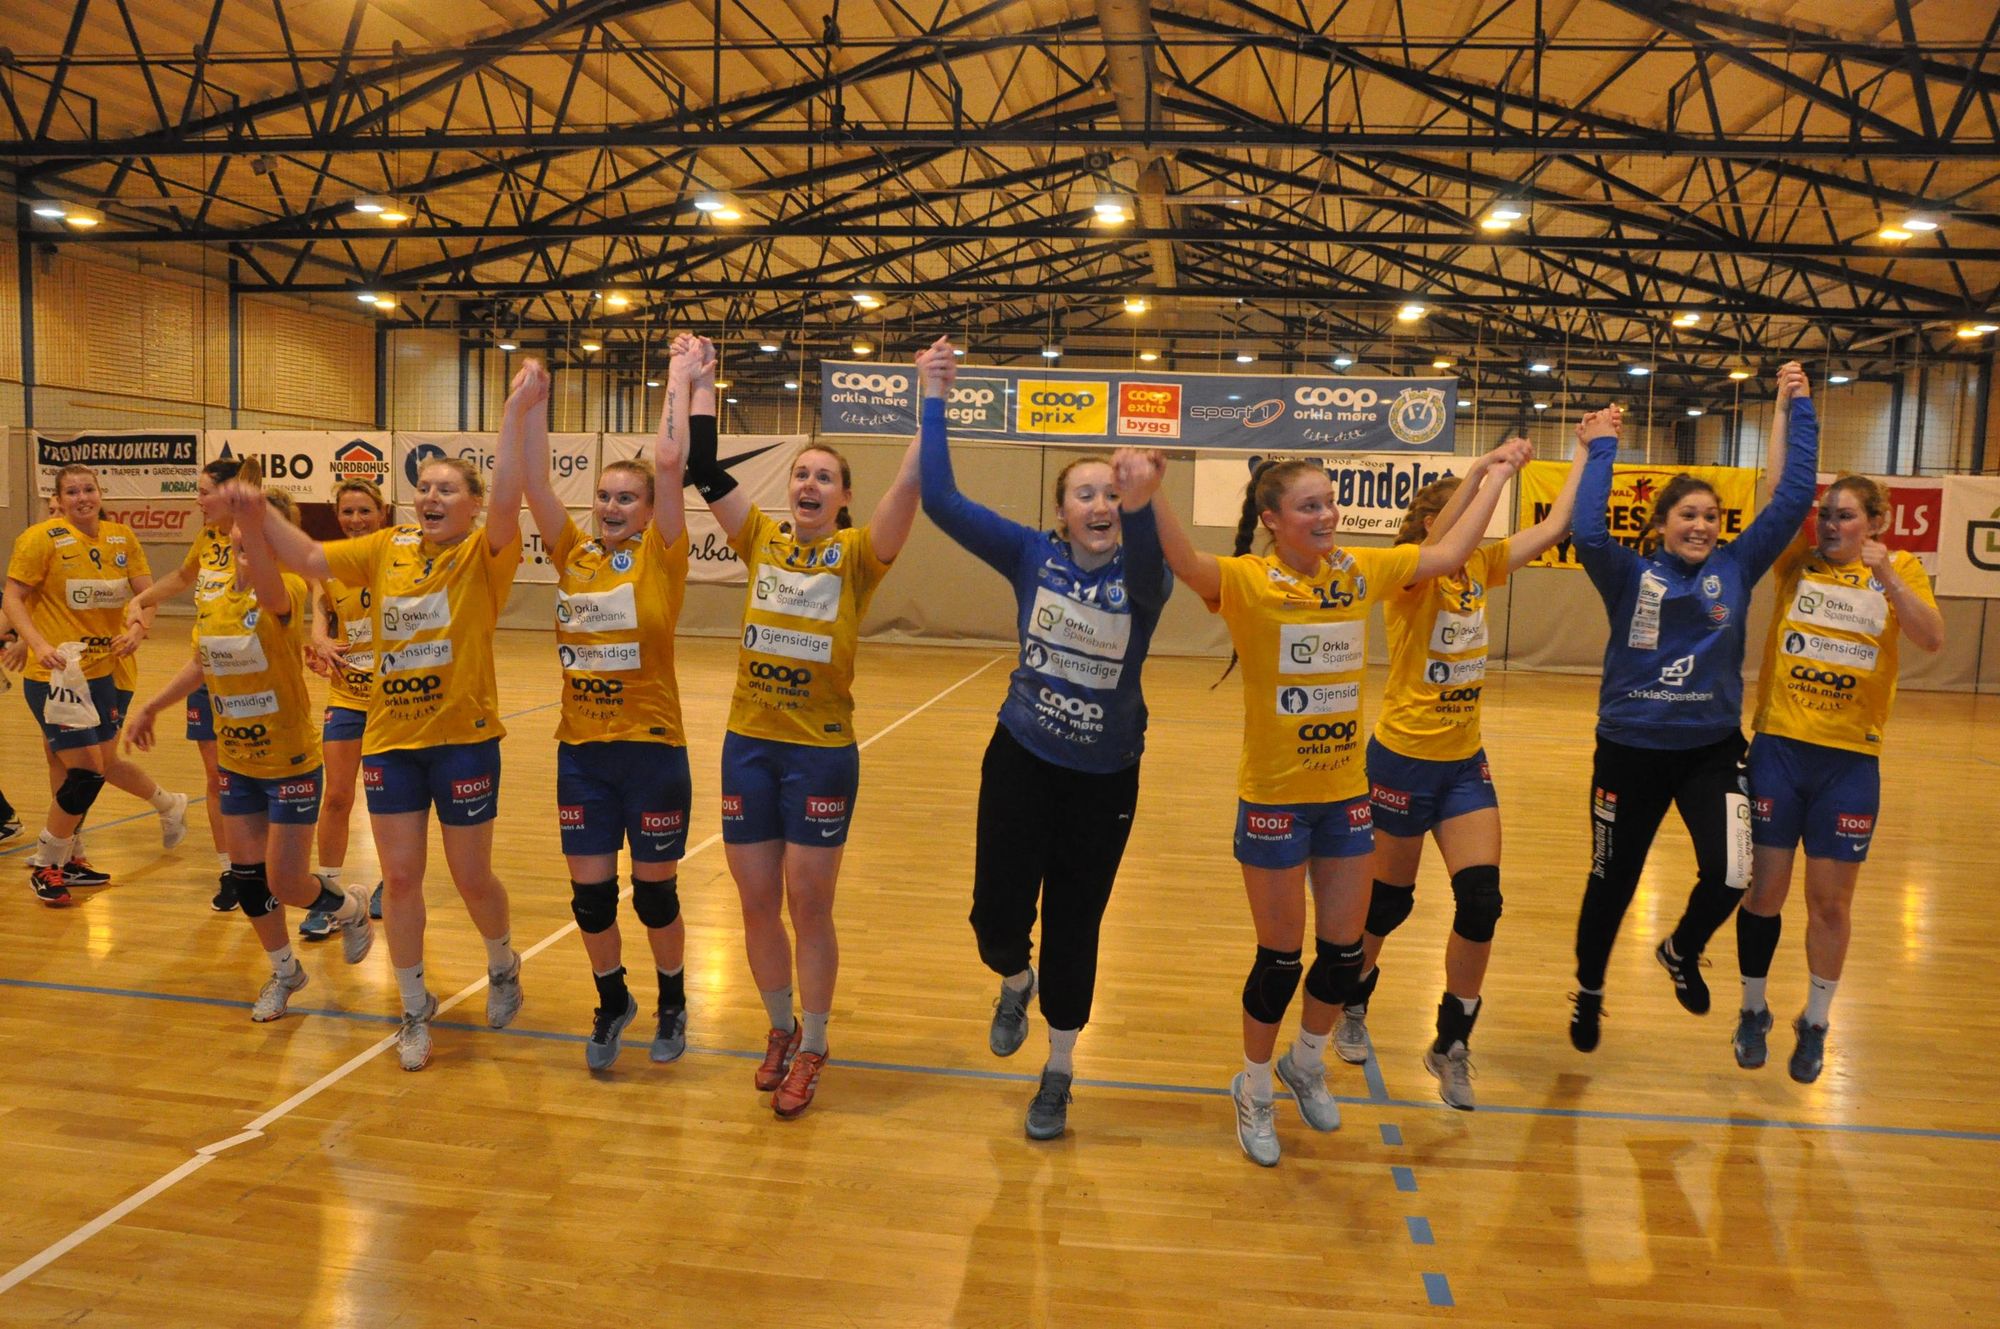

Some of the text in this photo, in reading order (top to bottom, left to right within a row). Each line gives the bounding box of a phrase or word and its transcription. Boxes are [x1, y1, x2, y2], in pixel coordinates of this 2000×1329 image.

[831, 370, 909, 397] coop
[831, 391, 908, 407] orkla møre
[947, 388, 994, 407] oop
[1031, 390, 1095, 410] coop
[1128, 390, 1172, 404] coop
[1294, 386, 1378, 411] coop
[944, 408, 986, 424] ega
[1127, 403, 1166, 414] extra
[1190, 405, 1253, 419] sport
[1294, 408, 1378, 422] orkla møre
[1031, 408, 1076, 426] prix
[1126, 420, 1171, 434] bygg
[44, 442, 192, 461] TRØNDERKJØKKEN AS
[330, 462, 390, 473] NORDBOHUS
[458, 448, 588, 477] Gjeige
[1342, 514, 1380, 528] følger
[88, 548, 102, 570] 9
[209, 543, 231, 567] 36
[360, 587, 371, 608] 6
[778, 584, 804, 597] Orkla
[575, 604, 599, 614] Orkla
[776, 594, 828, 610] Sparebank
[1826, 600, 1853, 612] Orkla
[1066, 618, 1095, 636] Orkla
[761, 630, 829, 652] Gjensidige
[1062, 628, 1118, 650] Sparebank
[1322, 640, 1349, 652] Orkla
[577, 646, 636, 661] Gjensidige
[1810, 638, 1874, 660] Gjensidige
[1051, 652, 1118, 679] Gjensidige
[750, 661, 812, 687] coop
[1790, 666, 1856, 690] coop
[382, 674, 440, 694] coop
[749, 680, 772, 692] orkla
[1788, 682, 1853, 700] orkla møre
[1312, 686, 1359, 704] Gjensidi
[1040, 688, 1104, 721] coop
[1035, 703, 1104, 732] orkla møre
[1298, 720, 1357, 742] coop
[1297, 742, 1330, 755] orkla
[364, 772, 379, 782] OLS
[280, 784, 314, 795] TOOLS
[456, 778, 490, 795] TOOLS
[1373, 788, 1407, 806] TOOLS
[722, 801, 738, 810] OLS
[810, 802, 845, 812] TOOLS
[1351, 806, 1371, 820] TOO
[1752, 800, 1768, 812] OLS
[560, 810, 580, 820] OLS
[644, 815, 680, 827] TOOLS
[1250, 816, 1289, 830] TOOLS
